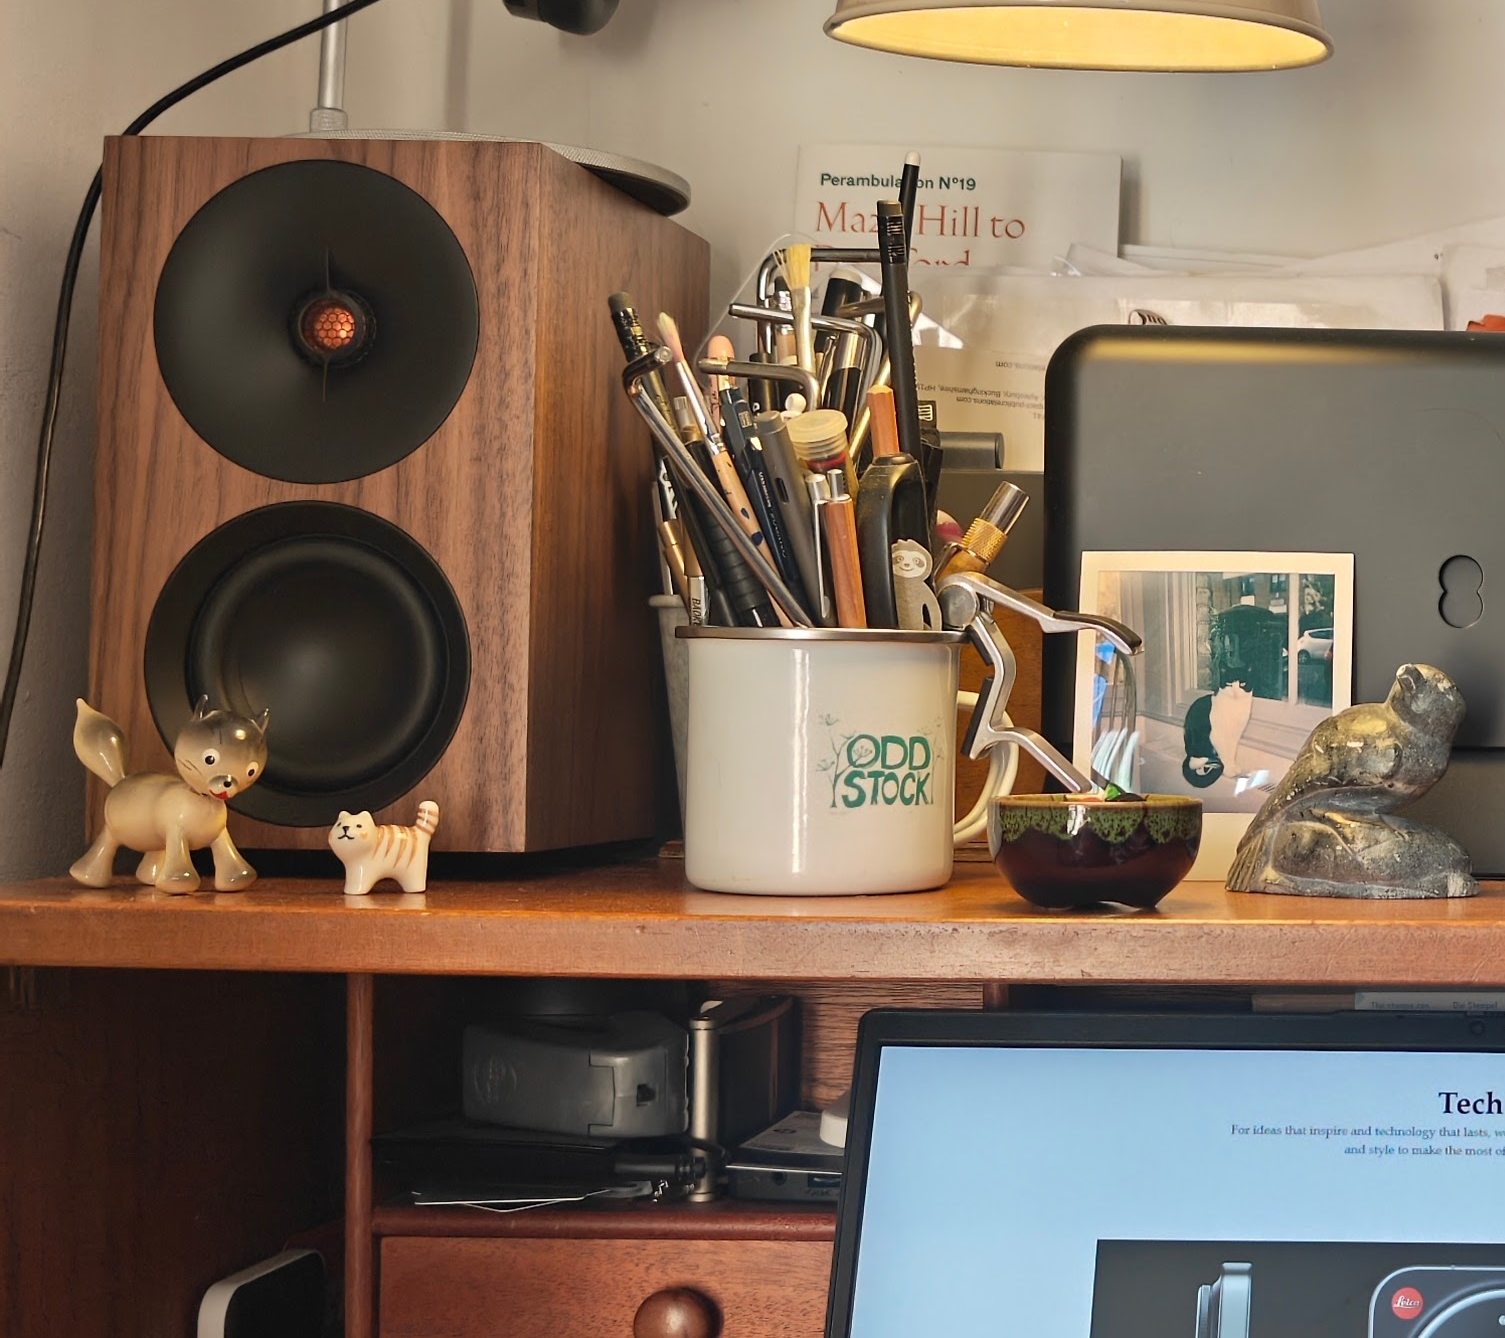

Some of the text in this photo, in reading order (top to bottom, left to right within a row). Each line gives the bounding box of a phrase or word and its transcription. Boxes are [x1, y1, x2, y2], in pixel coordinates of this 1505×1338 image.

[820, 174, 933, 189] Perambulaon
[816, 202, 1025, 239] Maz Hill to
[847, 734, 931, 772] ODD
[841, 771, 931, 808] STOCK
[1439, 1092, 1502, 1114] Tech
[1232, 1125, 1250, 1134] For
[1253, 1126, 1282, 1134] ideas
[1285, 1126, 1306, 1135] that
[1310, 1129, 1347, 1139] inspire
[1351, 1126, 1371, 1135] and
[1375, 1127, 1435, 1139] technology
[1439, 1127, 1460, 1136] that
[1464, 1128, 1490, 1137] lasts,
[1344, 1145, 1365, 1154] and
[1369, 1145, 1395, 1157] style
[1412, 1145, 1442, 1154] make
[1445, 1146, 1462, 1155] the
[1495, 1147, 1505, 1156] of
